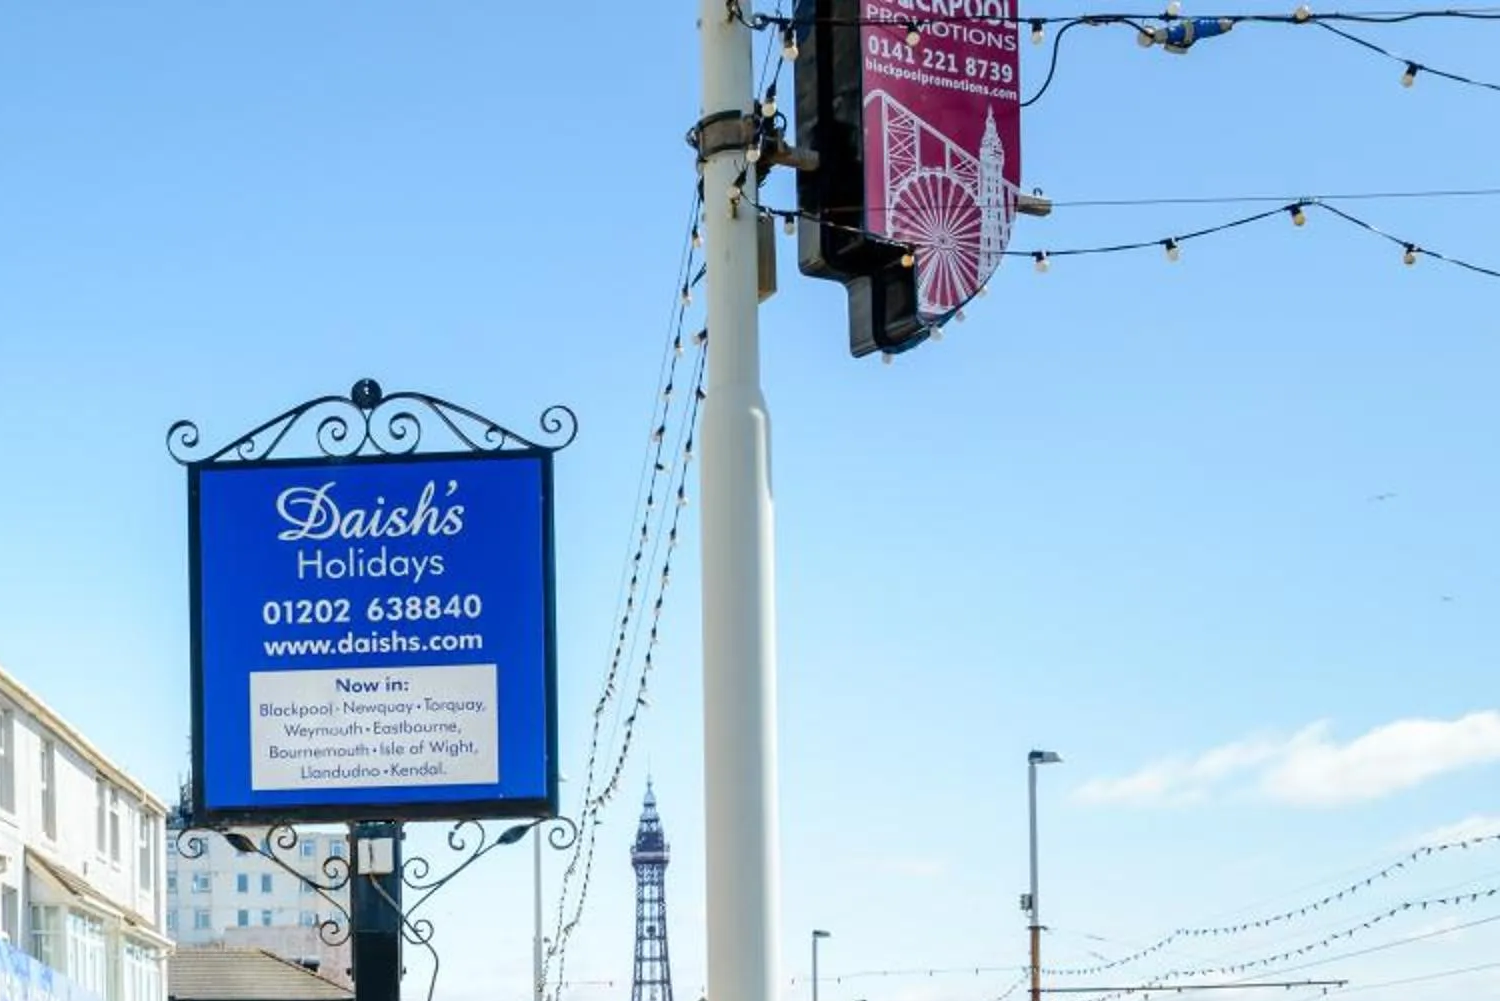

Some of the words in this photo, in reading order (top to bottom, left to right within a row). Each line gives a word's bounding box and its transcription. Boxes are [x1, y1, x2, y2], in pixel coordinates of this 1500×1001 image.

[886, 0, 1017, 29] CKPOOL
[868, 35, 915, 65] 0141
[923, 47, 958, 73] 221
[965, 57, 1012, 83] 8739
[865, 56, 1017, 100] blackpoolpromotions.com
[276, 480, 465, 541] Daish's
[297, 545, 445, 583] Holidays
[263, 598, 350, 625] 01202
[367, 594, 482, 621] 638840
[263, 630, 484, 657] www.daishs.com
[335, 678, 380, 693] Now
[385, 676, 410, 692] in:
[259, 702, 334, 719] Blackpool
[343, 700, 414, 717] Newquay
[284, 722, 364, 740] Weymouth
[269, 744, 369, 759] Bournemouth
[380, 741, 405, 757] Isle
[409, 740, 424, 755] of
